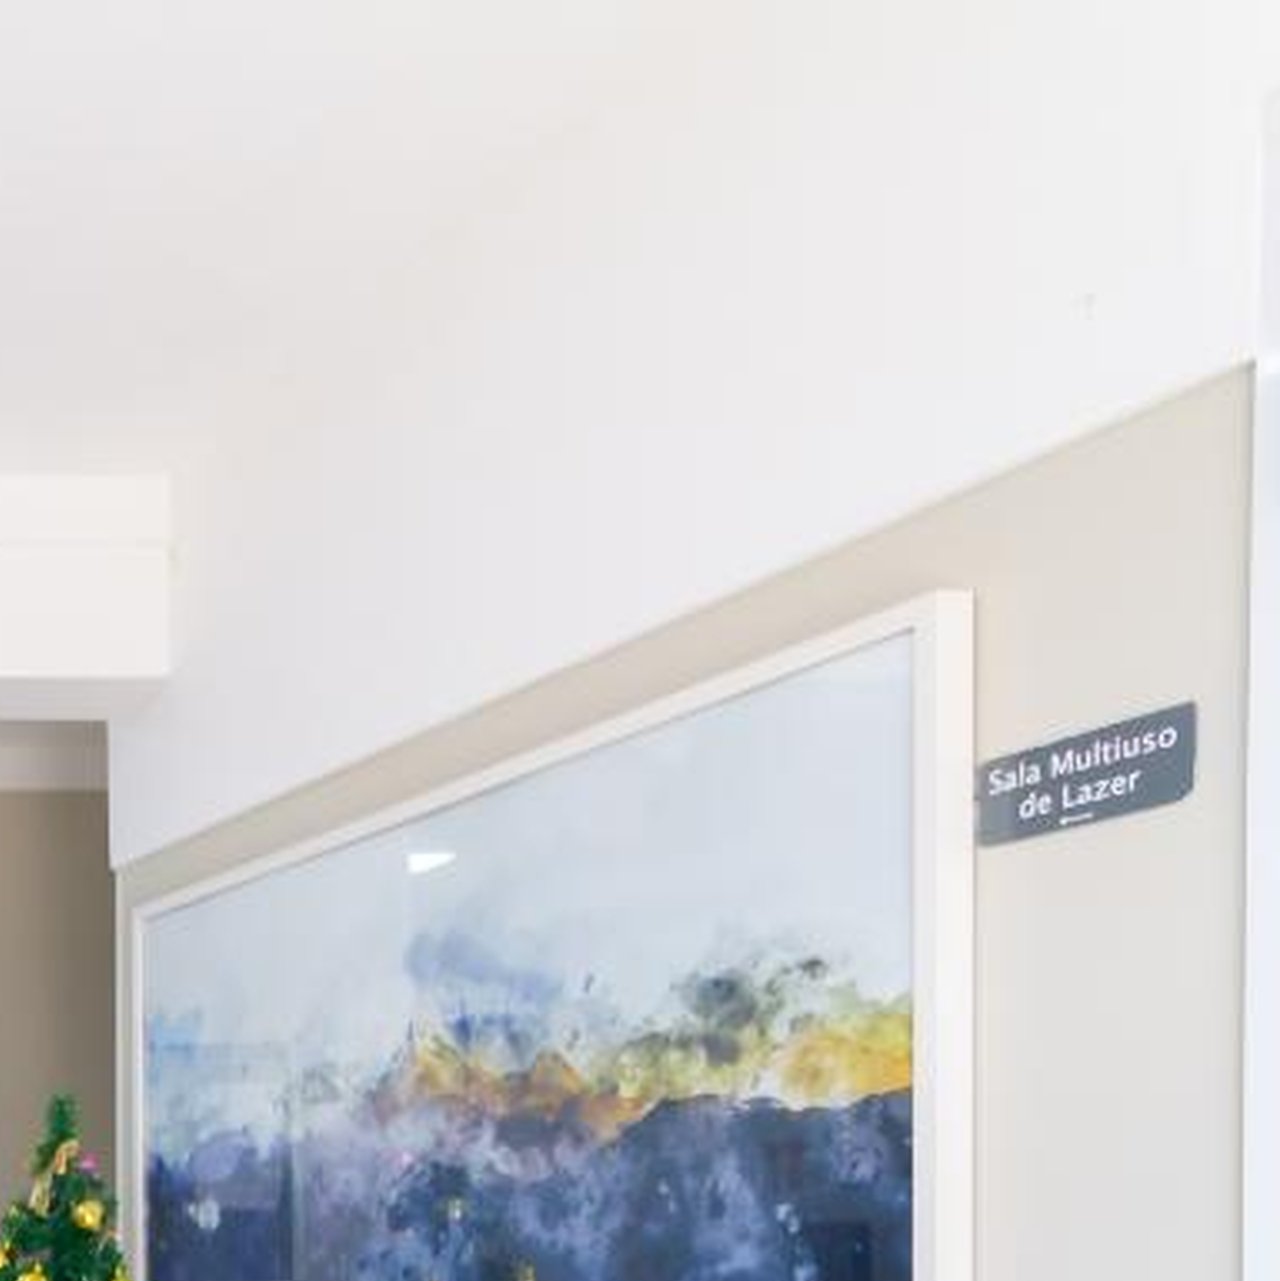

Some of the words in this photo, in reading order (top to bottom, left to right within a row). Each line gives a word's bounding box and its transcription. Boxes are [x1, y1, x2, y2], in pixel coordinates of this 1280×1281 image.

[988, 763, 1042, 796] Sala
[1050, 726, 1178, 779] Multiuso
[1018, 791, 1052, 820] de
[1061, 769, 1143, 809] Lazer
